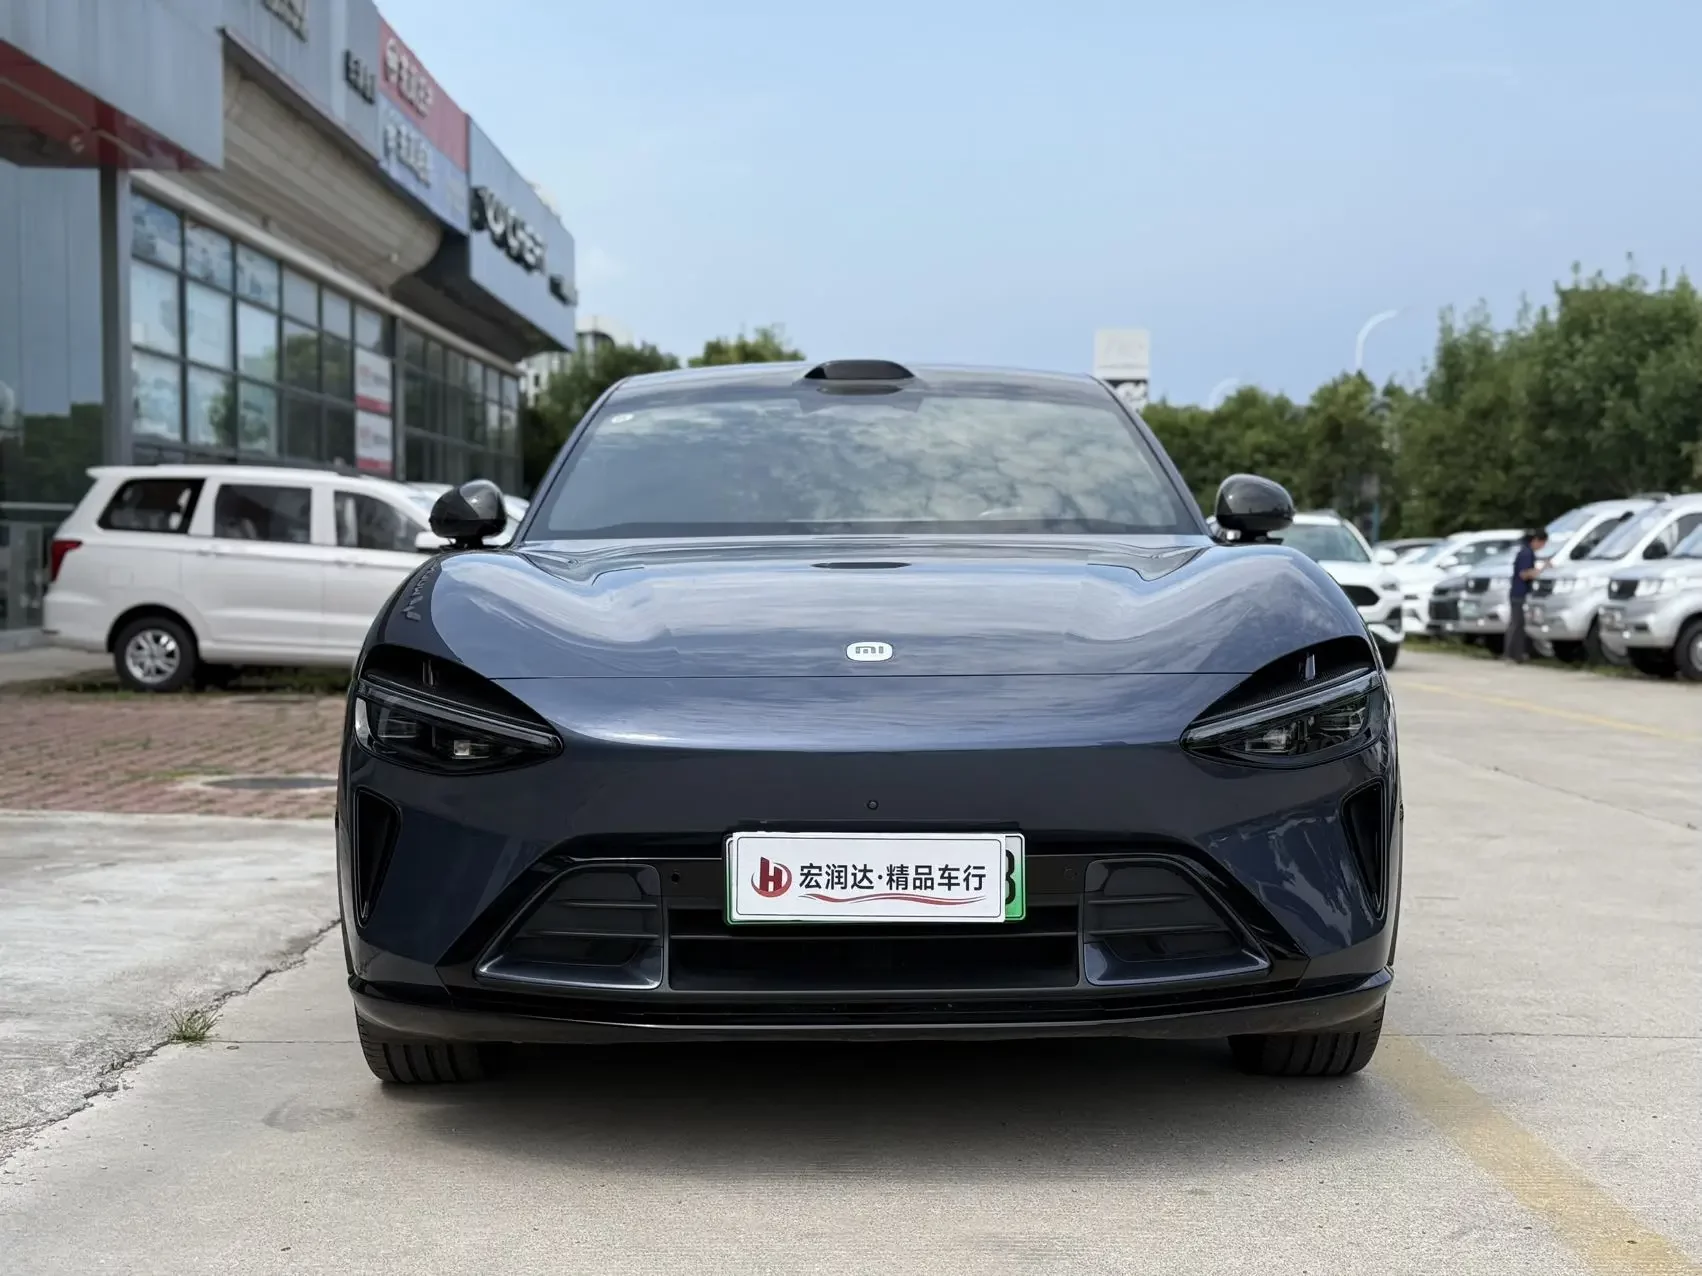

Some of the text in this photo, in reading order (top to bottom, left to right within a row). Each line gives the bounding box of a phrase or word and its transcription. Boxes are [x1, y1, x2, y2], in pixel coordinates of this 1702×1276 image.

[799, 862, 987, 891] 宏润达·精品车行
